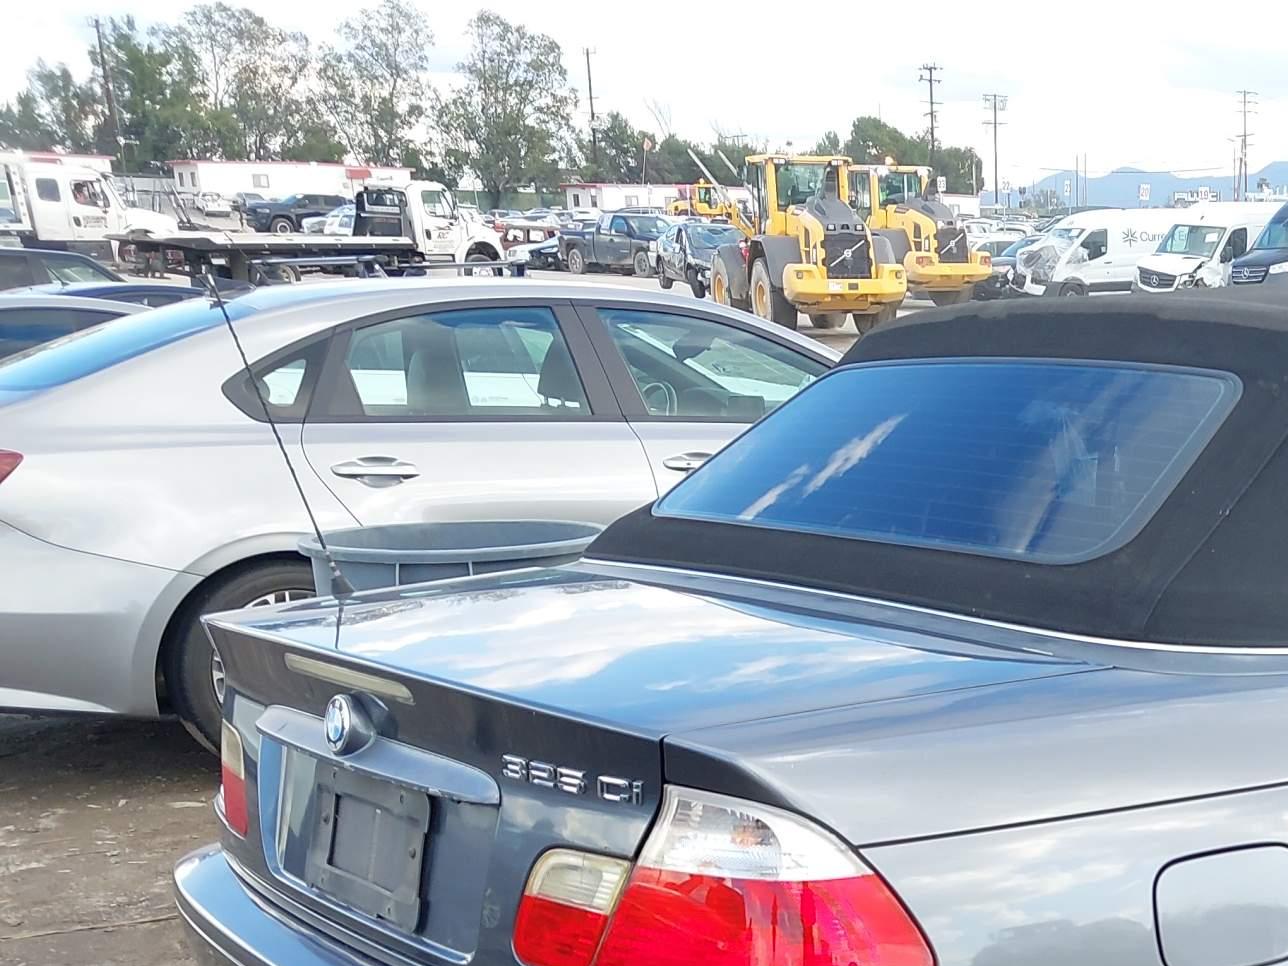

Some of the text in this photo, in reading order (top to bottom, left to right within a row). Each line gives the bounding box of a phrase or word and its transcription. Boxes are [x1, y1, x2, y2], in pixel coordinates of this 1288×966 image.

[1140, 186, 1149, 197] 20
[1200, 190, 1209, 200] 19
[502, 753, 644, 806] 325 Ci
